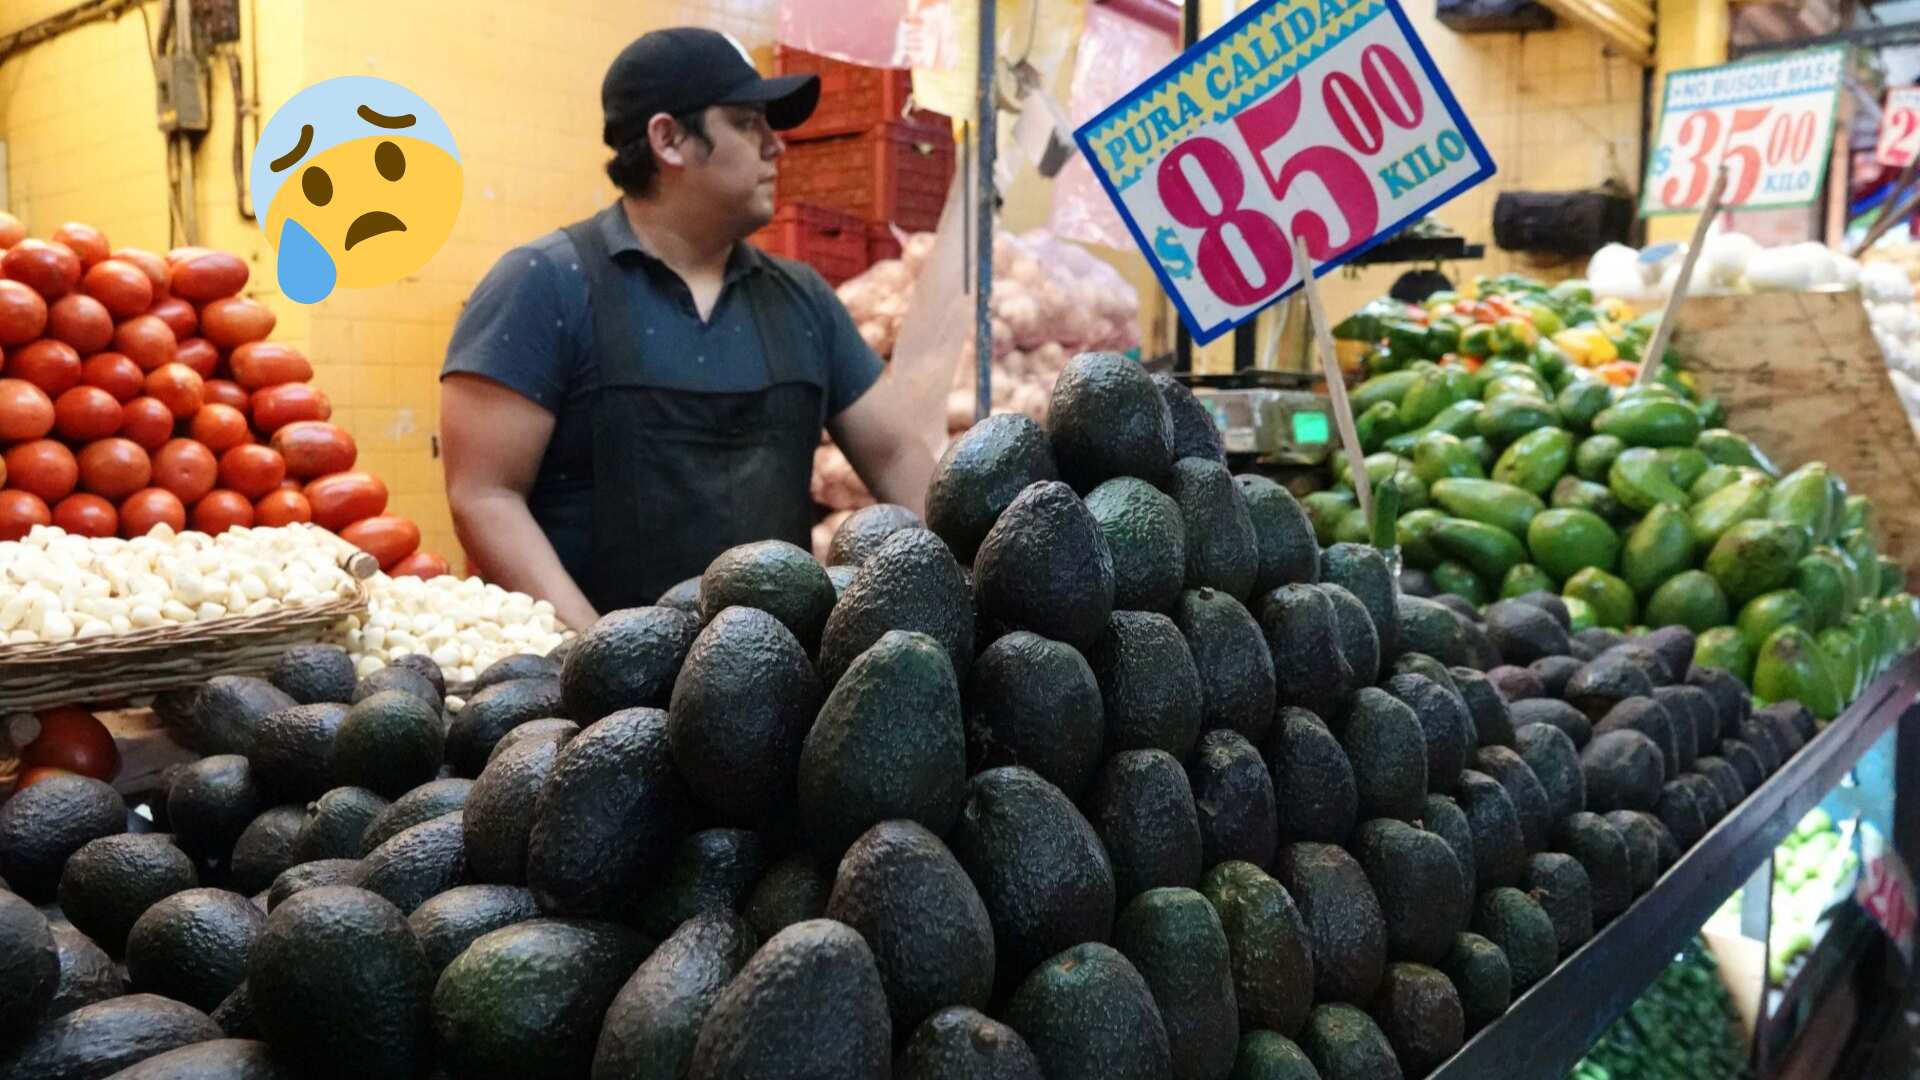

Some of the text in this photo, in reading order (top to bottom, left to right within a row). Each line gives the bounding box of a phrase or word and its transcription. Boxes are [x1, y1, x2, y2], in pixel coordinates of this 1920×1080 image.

[1105, 0, 1362, 171] PURA CALIDA
[1378, 129, 1466, 199] KILO
[1763, 170, 1810, 193] KILO
